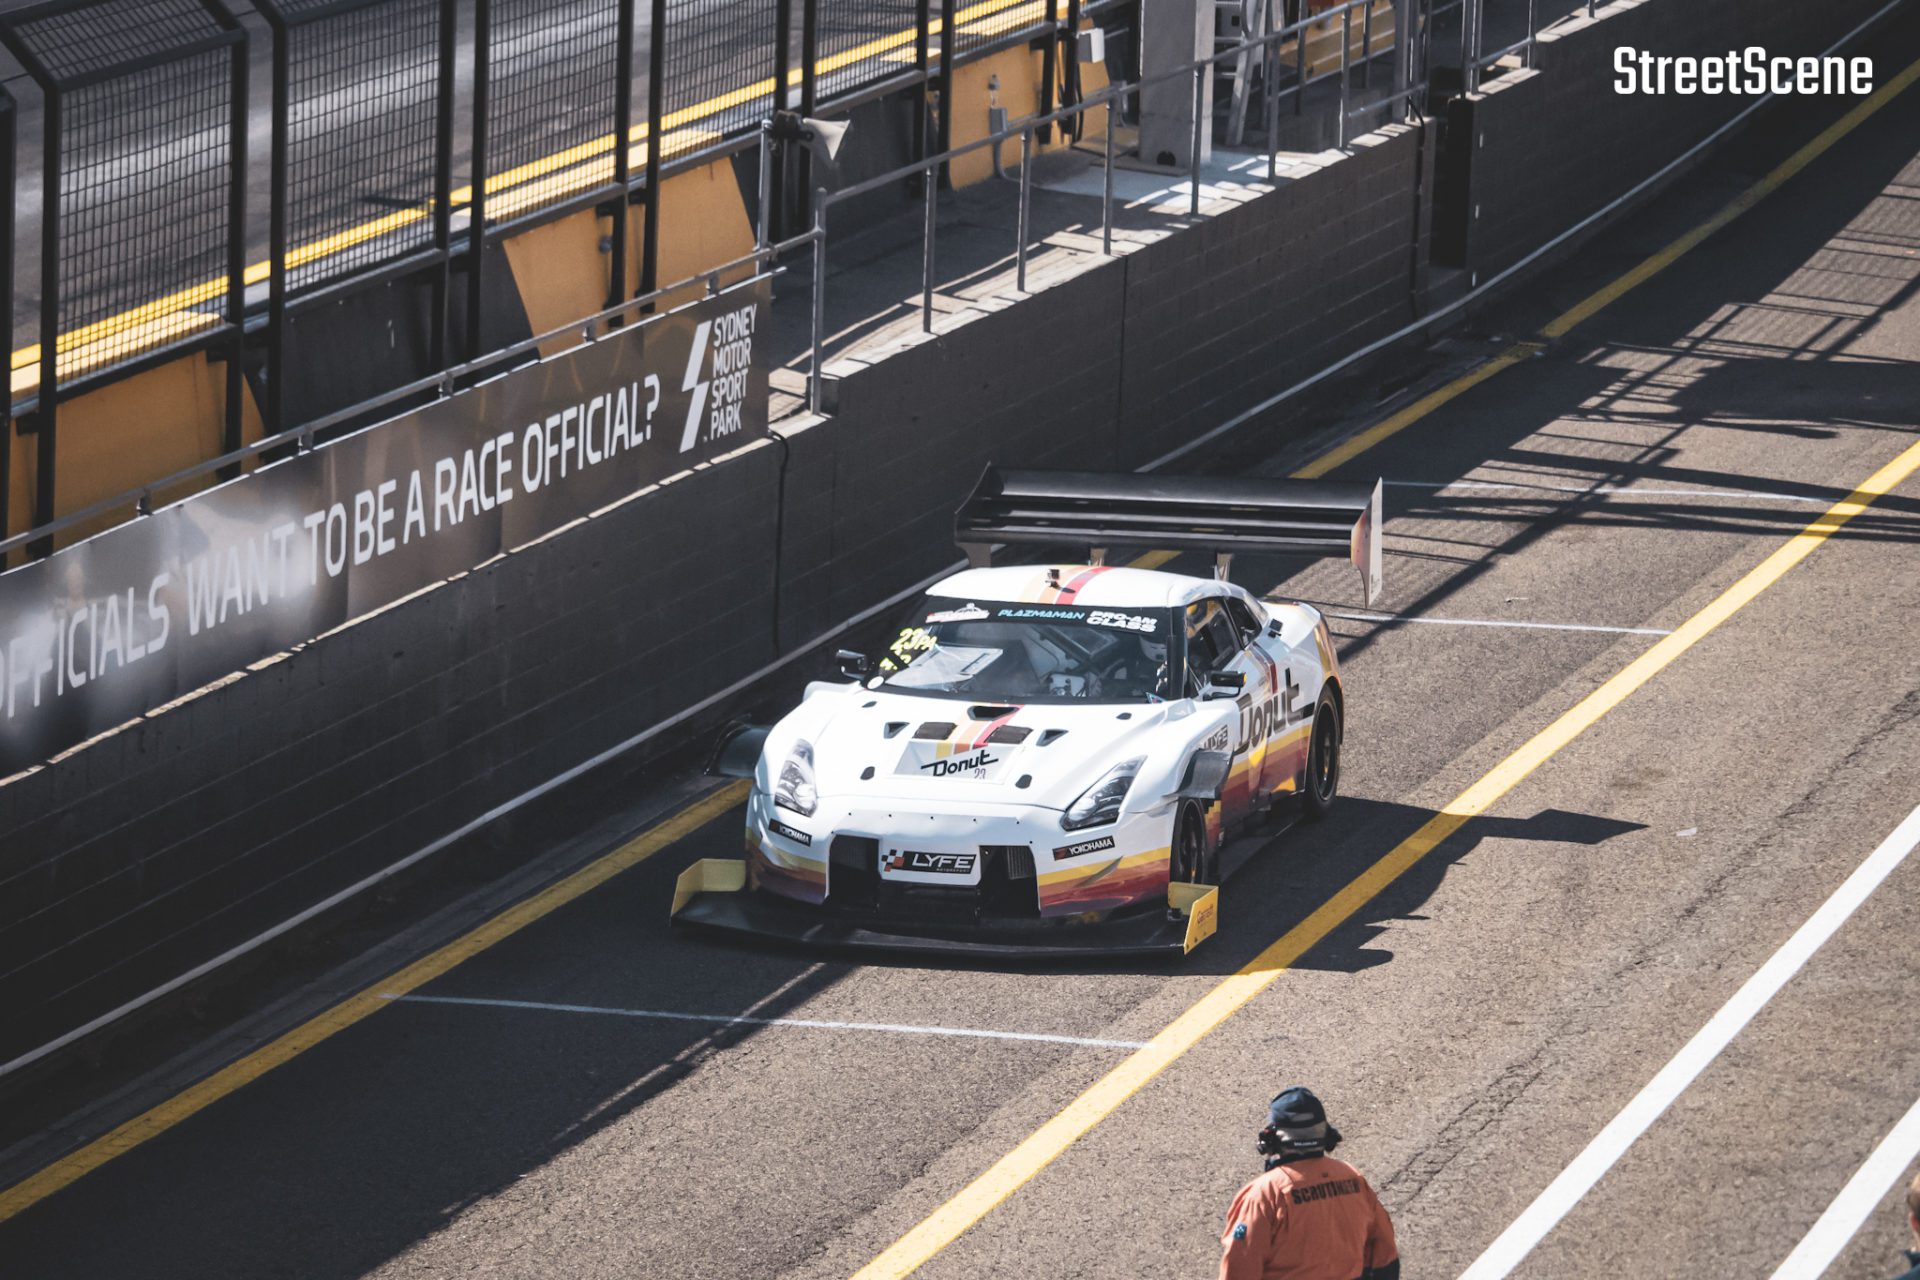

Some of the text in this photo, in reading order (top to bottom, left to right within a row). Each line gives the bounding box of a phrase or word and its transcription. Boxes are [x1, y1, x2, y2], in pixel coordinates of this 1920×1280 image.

[713, 303, 758, 348] SYDNEY
[712, 337, 751, 379] MOTOR
[711, 367, 749, 410] SPORT
[710, 401, 742, 441] PARK
[0, 373, 661, 720] FFICIALS WANT TO BE A RACE OFFICIAL?
[997, 608, 1085, 621] PLAZMAMAN
[1086, 616, 1157, 633] CLASS
[920, 749, 999, 778] Donut
[911, 853, 975, 869] LYFE
[1068, 838, 1113, 855] YOKOHAMA
